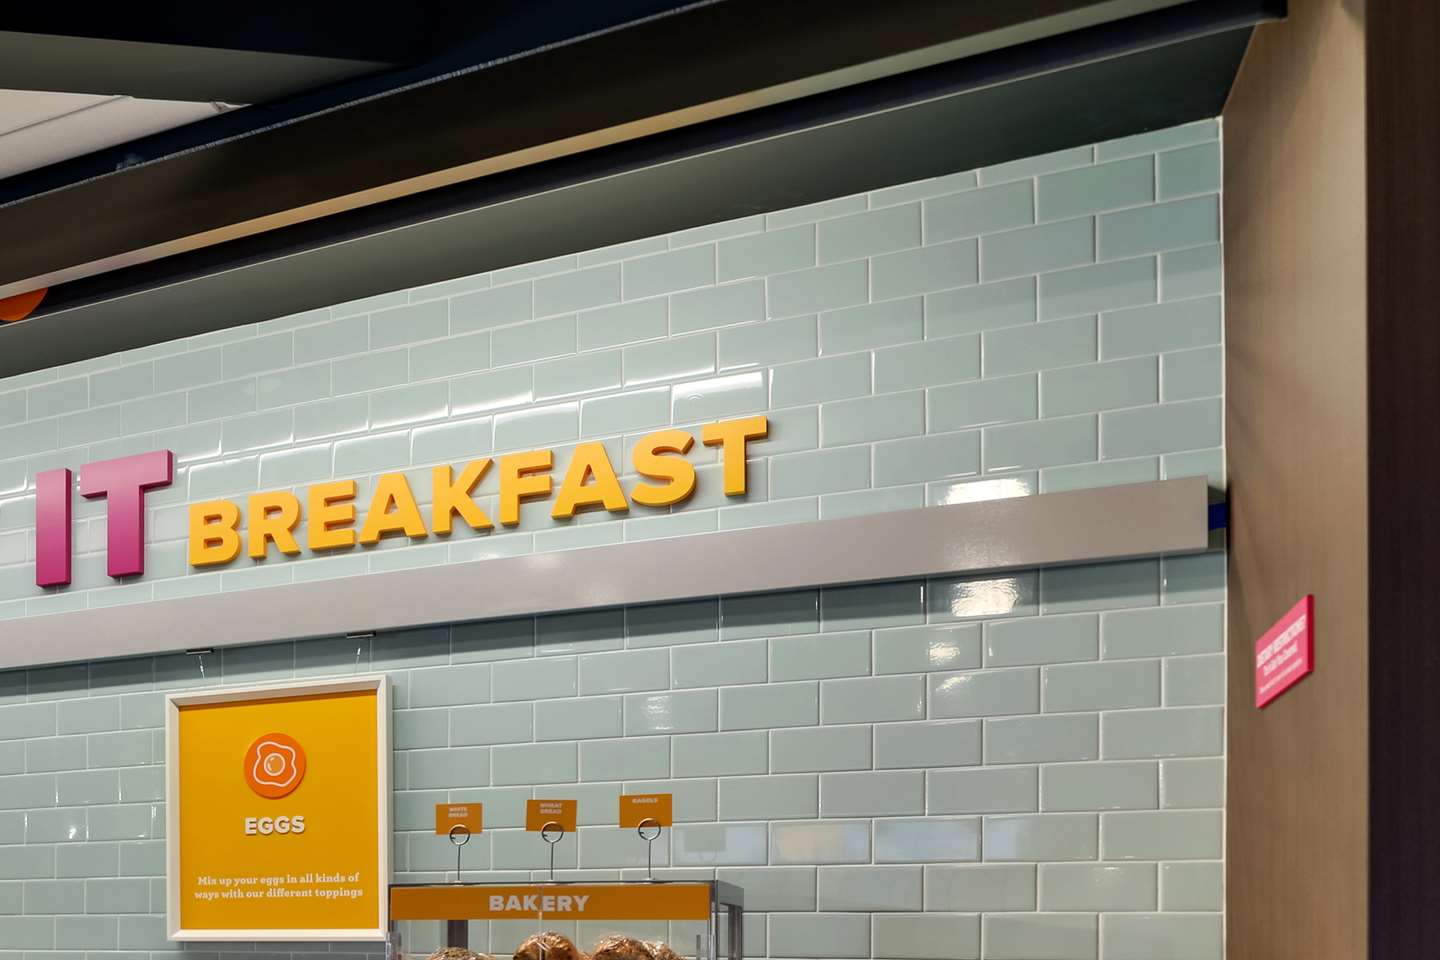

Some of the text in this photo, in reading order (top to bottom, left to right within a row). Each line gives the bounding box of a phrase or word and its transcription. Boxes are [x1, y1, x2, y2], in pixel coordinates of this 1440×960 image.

[35, 449, 173, 588] IT
[188, 415, 768, 567] BREAKFAST
[245, 816, 305, 835] EGGS
[198, 872, 361, 887] Mix up your eggs in all kinds of
[194, 887, 363, 900] ways with our different toppings
[488, 895, 590, 912] BAKERY
